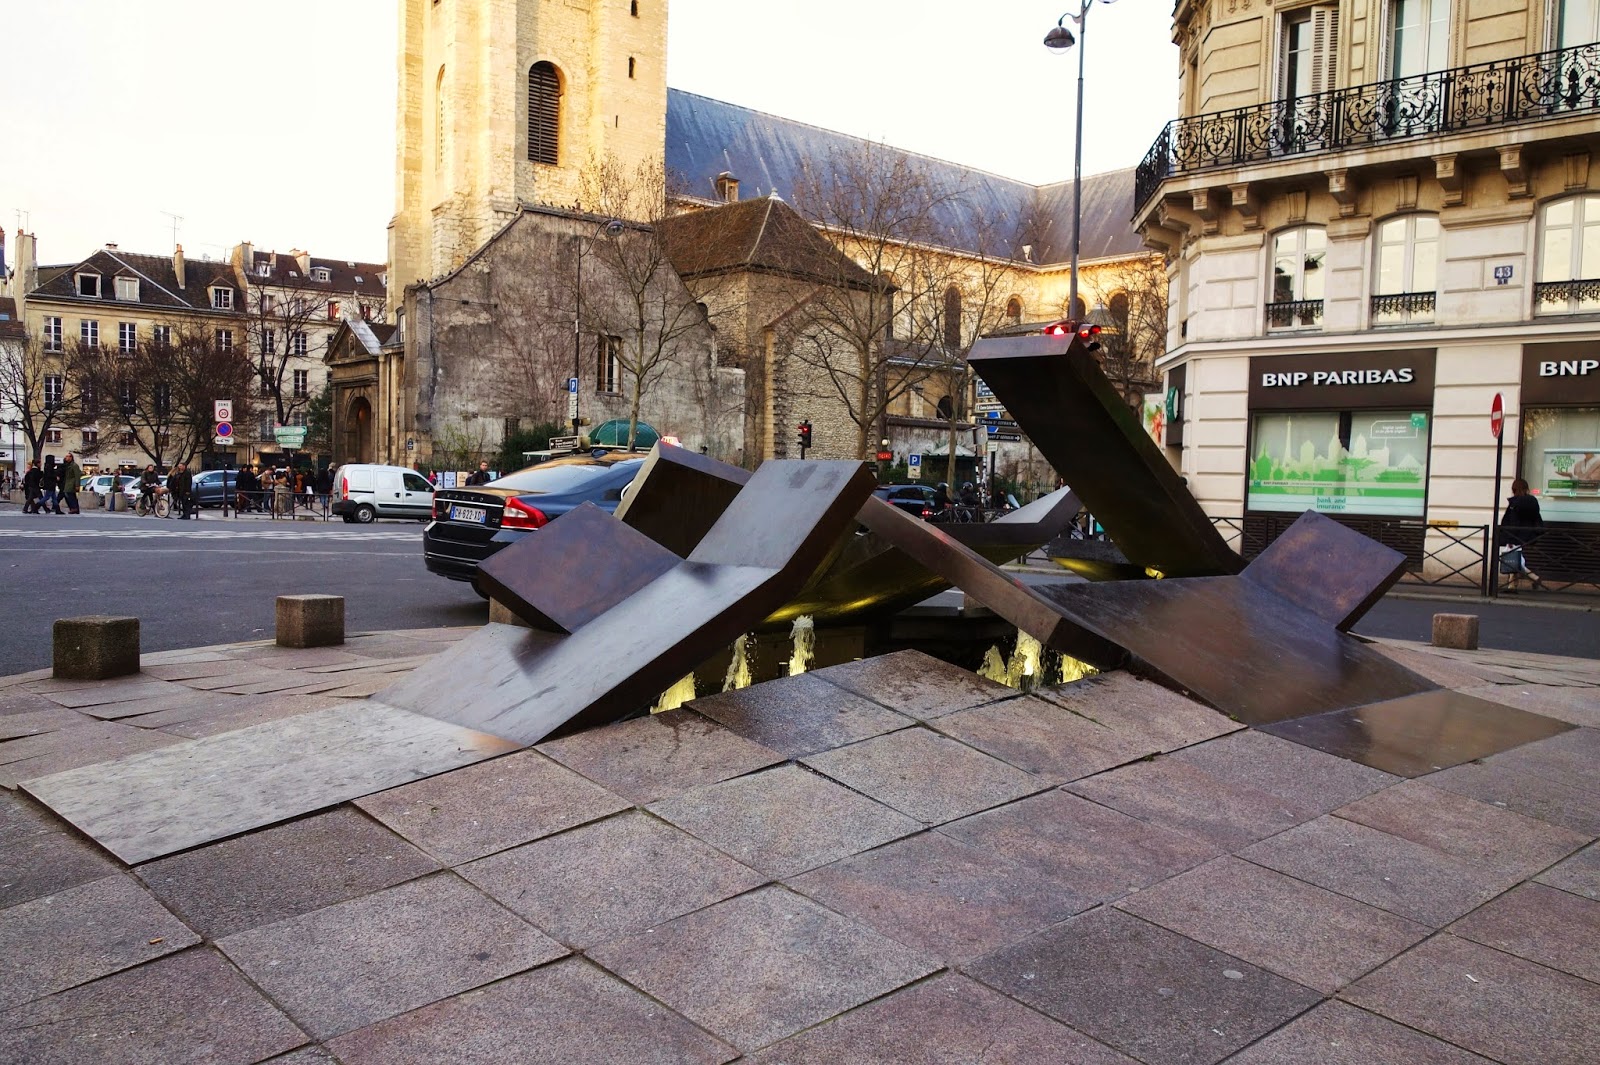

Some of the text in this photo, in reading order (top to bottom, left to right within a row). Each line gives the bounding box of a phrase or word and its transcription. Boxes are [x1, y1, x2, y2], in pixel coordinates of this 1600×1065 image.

[1496, 267, 1511, 278] 43
[1540, 359, 1600, 376] BNP
[1262, 368, 1414, 387] BNP PARIBAS
[571, 381, 576, 391] P
[911, 456, 918, 465] P
